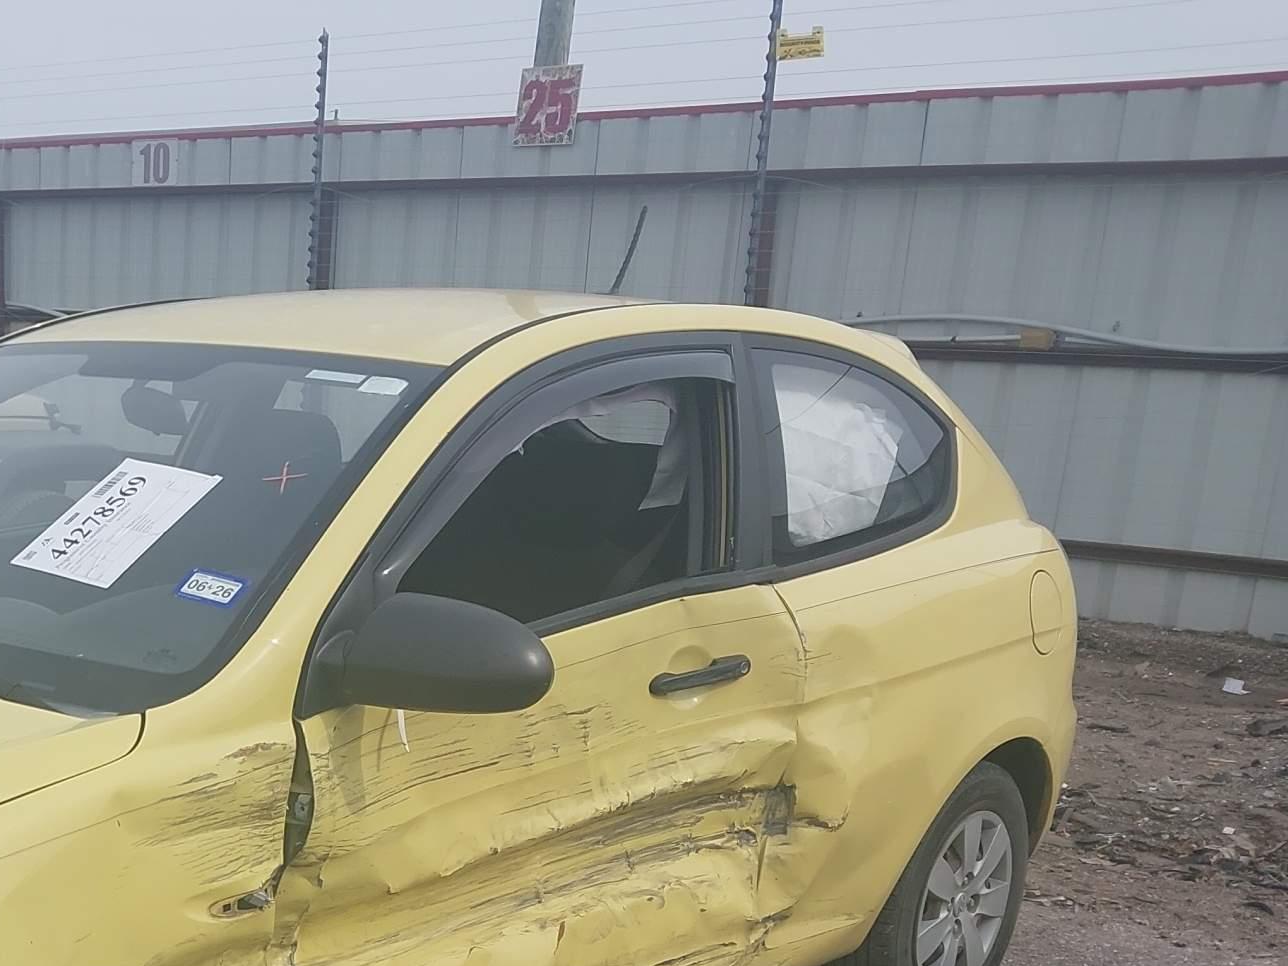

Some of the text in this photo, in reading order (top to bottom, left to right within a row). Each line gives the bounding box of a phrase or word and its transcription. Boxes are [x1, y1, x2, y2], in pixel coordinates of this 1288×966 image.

[519, 79, 575, 136] 25
[139, 142, 170, 184] 10
[50, 476, 147, 560] 44278569
[187, 579, 234, 599] 06 26
